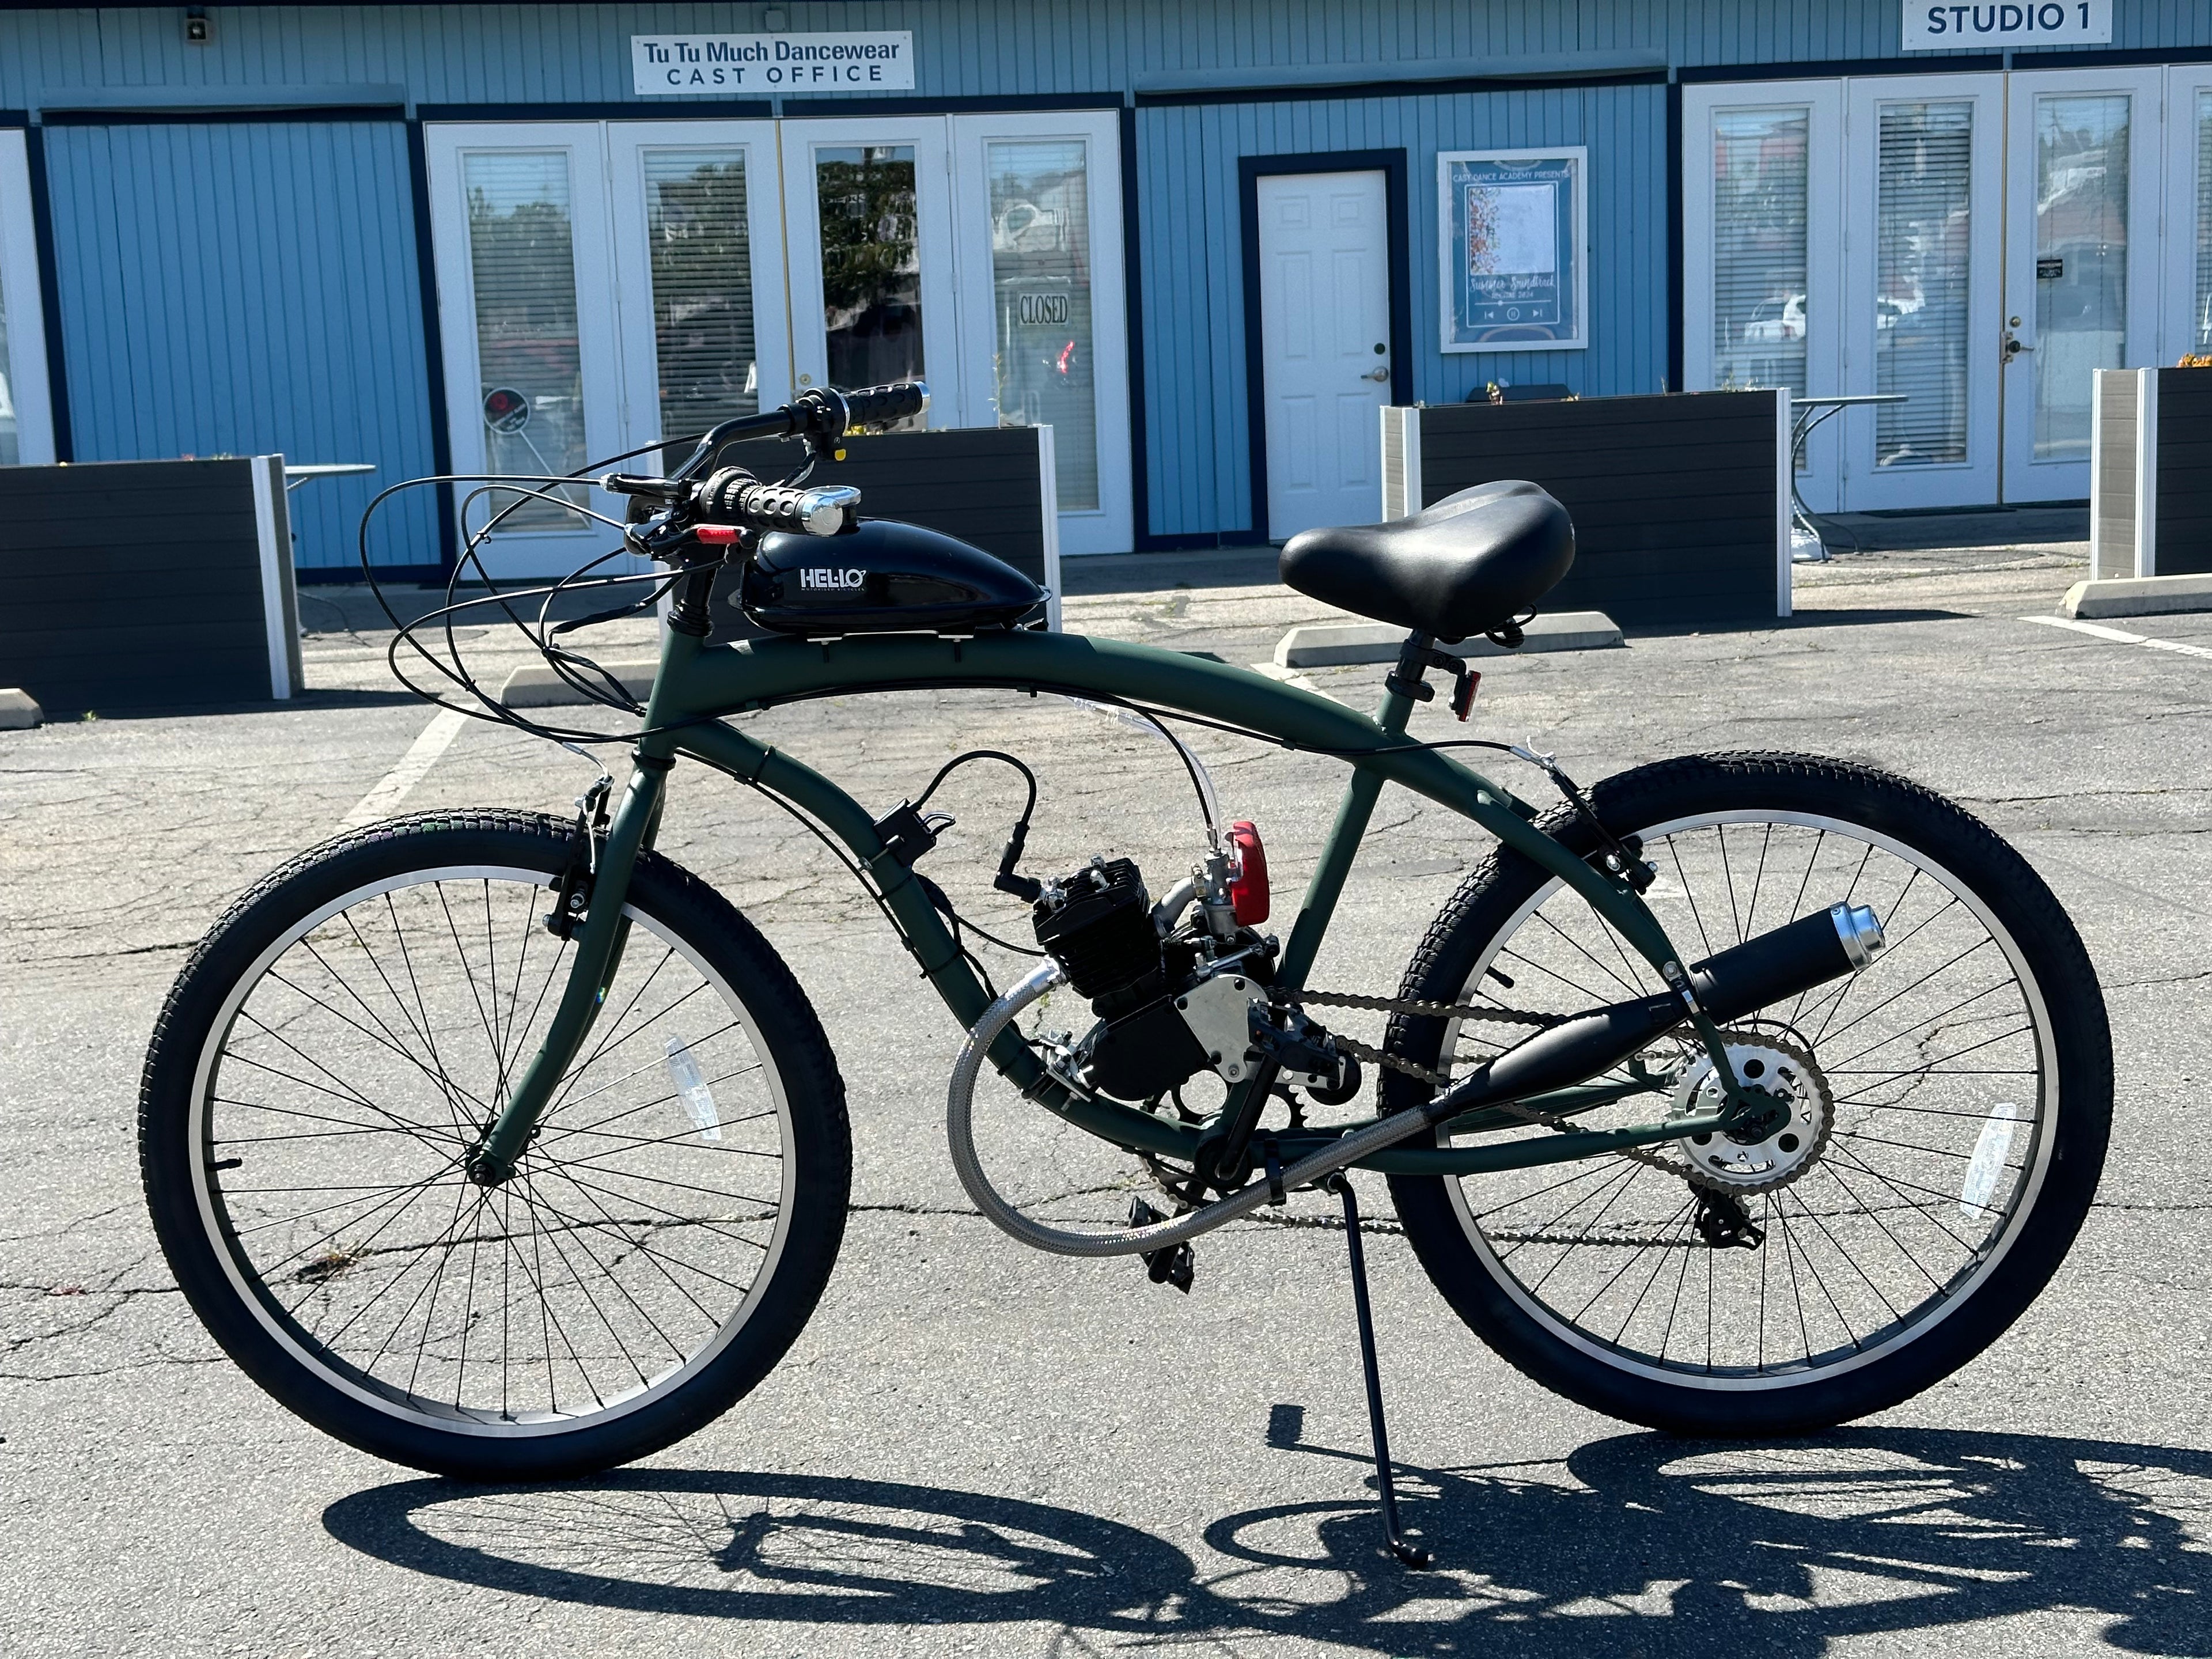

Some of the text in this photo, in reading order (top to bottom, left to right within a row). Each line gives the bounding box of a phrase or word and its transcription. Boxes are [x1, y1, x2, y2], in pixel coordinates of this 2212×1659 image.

[1927, 2, 2089, 33] STUDIO 1
[644, 41, 899, 63] Tu Tu Much Dancewear
[666, 65, 882, 85] CAST OFFICE
[1453, 175, 1470, 183] CAST
[1473, 173, 1497, 181] DANCE
[1499, 172, 1532, 180] ACADEMY
[1020, 296, 1067, 324] CLOSED
[800, 569, 866, 588] HELIO
